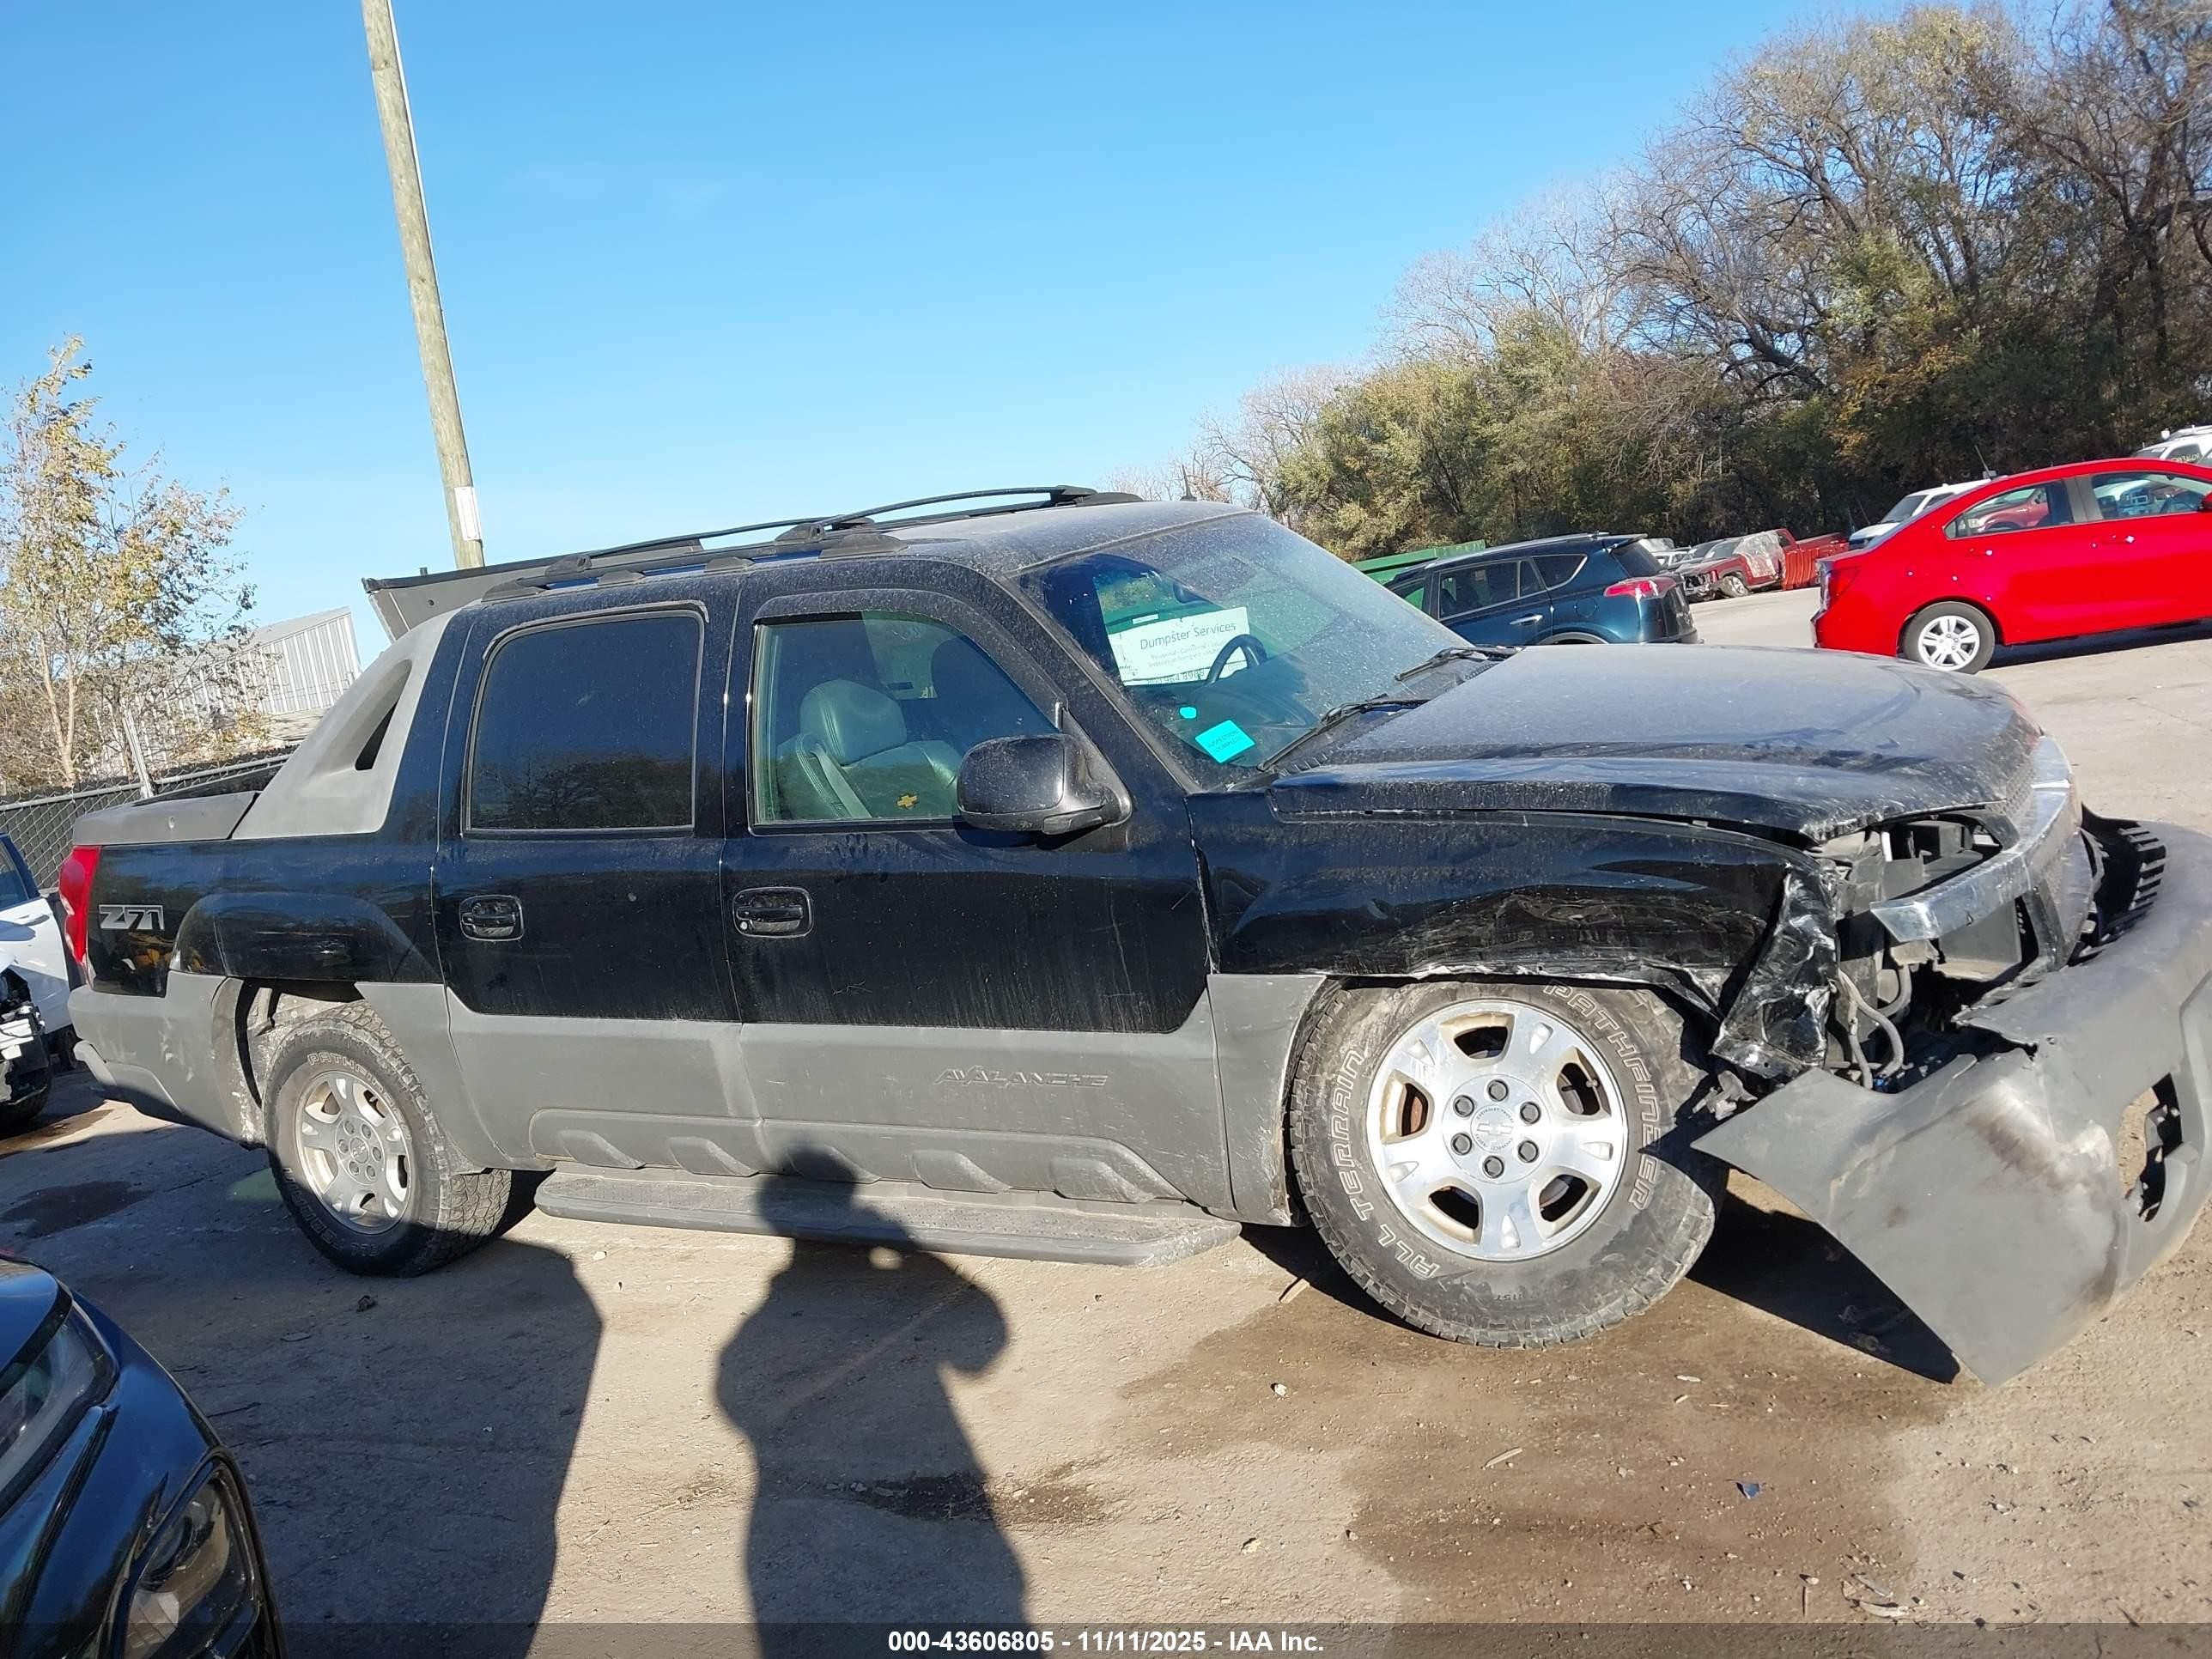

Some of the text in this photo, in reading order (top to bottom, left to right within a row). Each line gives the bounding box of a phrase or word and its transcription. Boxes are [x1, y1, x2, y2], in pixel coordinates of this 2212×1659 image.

[1140, 629, 1191, 650] Dumpster
[1194, 623, 1237, 637] Services
[99, 904, 165, 930] Z71
[933, 1065, 1109, 1087] AVALANCHE
[1543, 980, 1662, 1210] PATHFINDER
[1331, 1049, 1443, 1279] ALL TERRAIN
